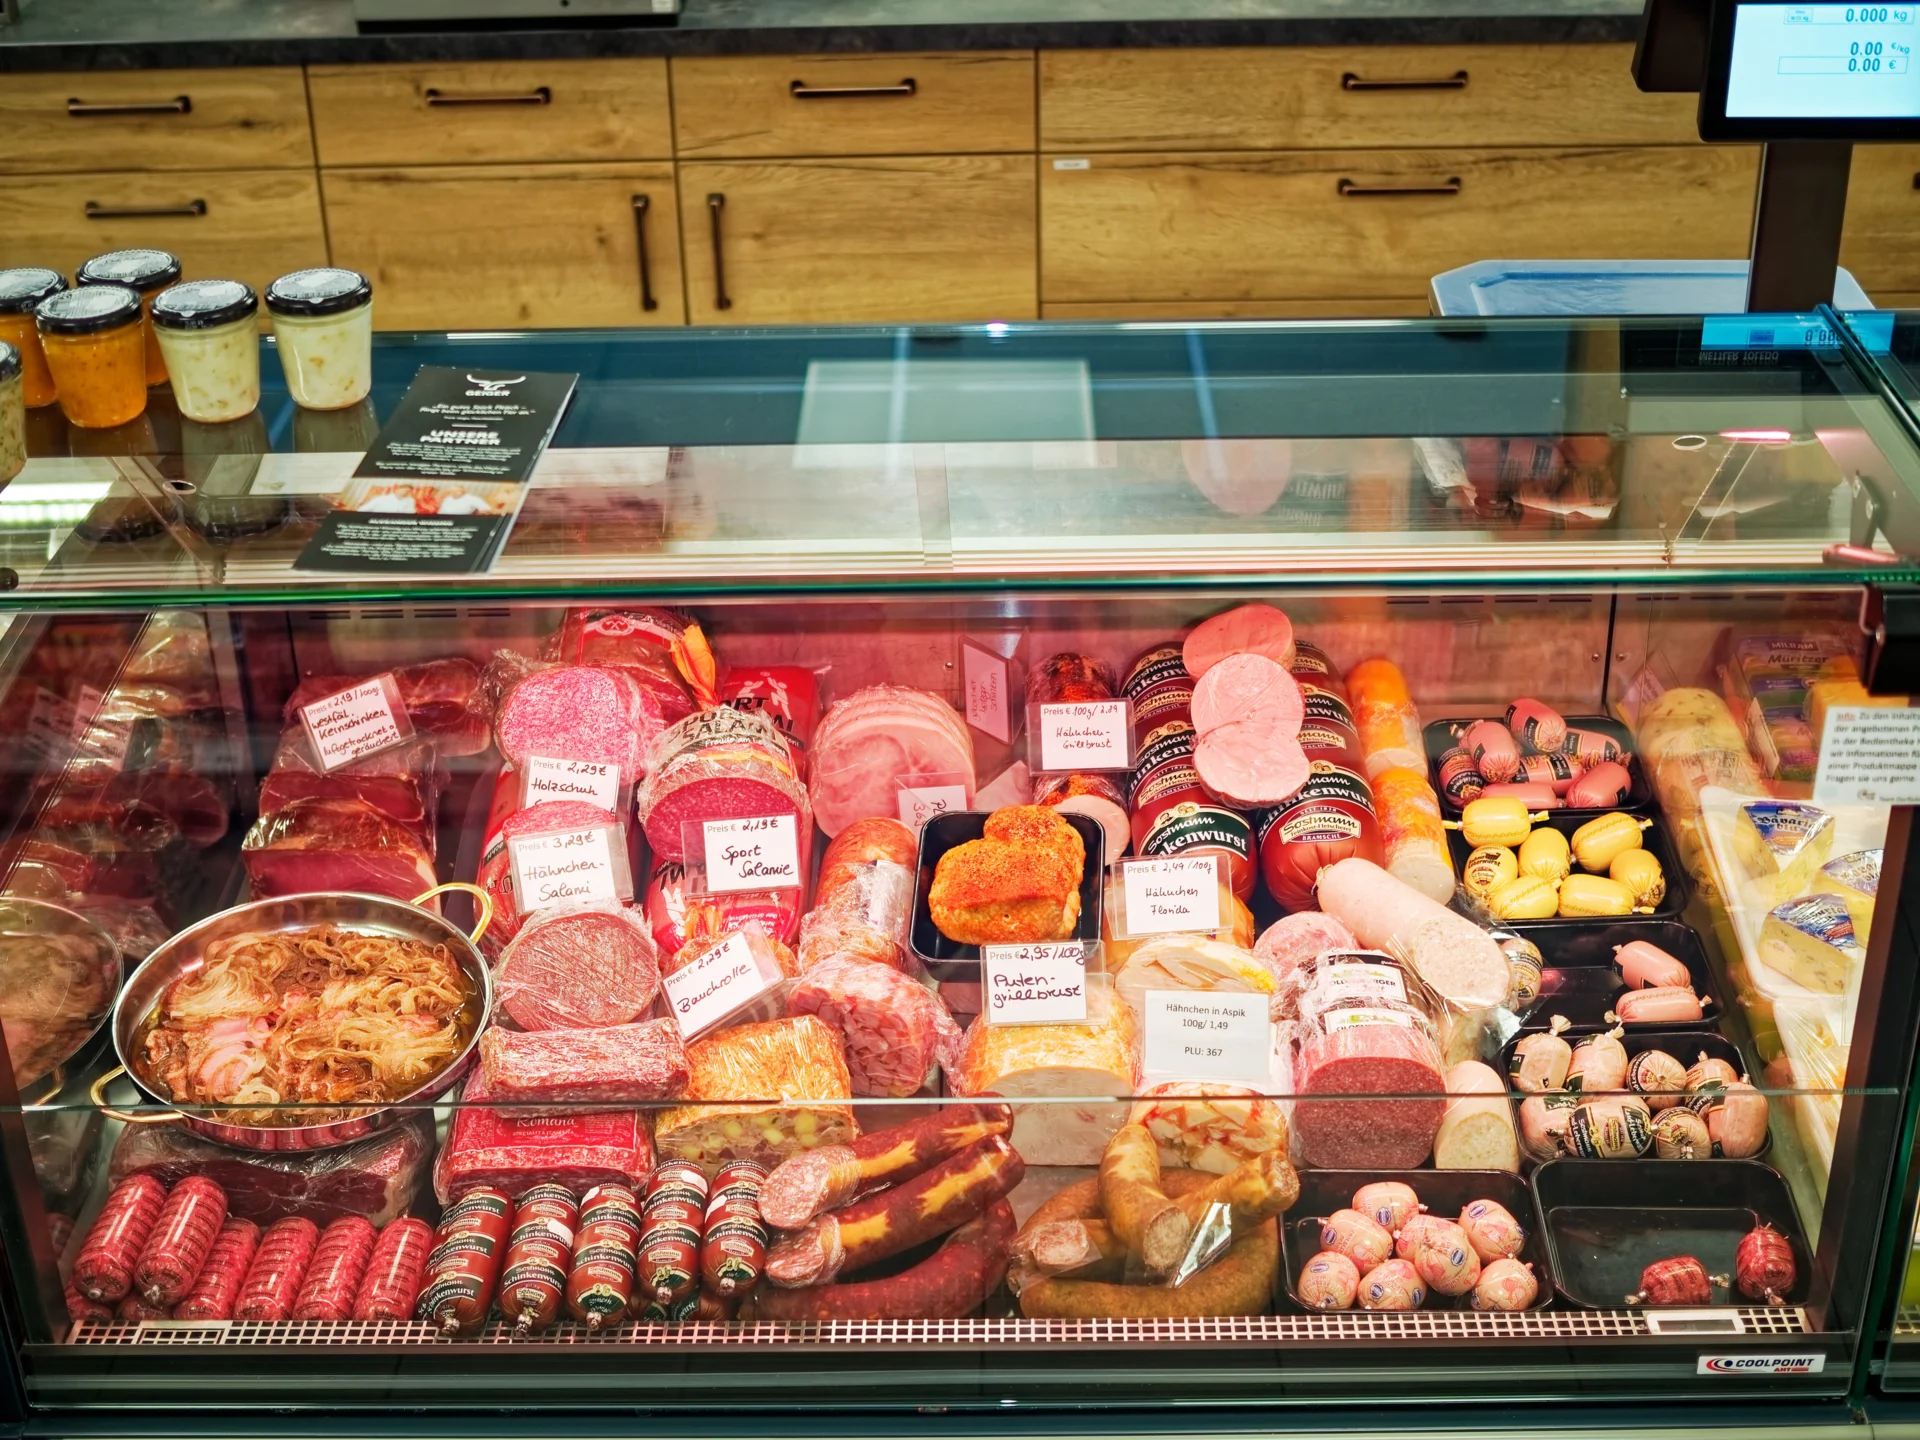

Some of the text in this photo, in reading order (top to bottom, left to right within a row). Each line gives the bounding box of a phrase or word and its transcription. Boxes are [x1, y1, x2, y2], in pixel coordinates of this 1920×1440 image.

[1845, 8, 1908, 23] 0.000 kg
[1850, 41, 1910, 56] 0.00 €/kg
[1848, 58, 1897, 72] 0.00 €
[430, 430, 499, 439] UNSERE
[419, 435, 501, 446] PARTNER
[307, 705, 328, 717] Preis
[1043, 707, 1064, 716] Preis
[533, 759, 554, 770] Preis
[707, 824, 729, 834] Preis
[1283, 815, 1358, 835] Sostmann
[1147, 816, 1216, 854] Sostmann
[1302, 833, 1341, 841] BRAMSCHE
[519, 842, 541, 852] Preis
[722, 844, 762, 866] Sport
[523, 860, 606, 881] Hähnchen-
[1127, 865, 1149, 874] Preis
[1145, 885, 1199, 898] Hähnchen
[1150, 905, 1190, 916] Florida
[990, 951, 1012, 961] Preis
[667, 973, 687, 987] Preis
[993, 972, 1055, 987] Puten-
[677, 964, 751, 1013] Bauchrolle
[1166, 1003, 1246, 1018] Hähnchen in Aspik
[1182, 1019, 1229, 1030] 100g/ 1,49
[1184, 1046, 1223, 1057] PLU: 367
[1735, 1358, 1815, 1368] COOLPOINT
